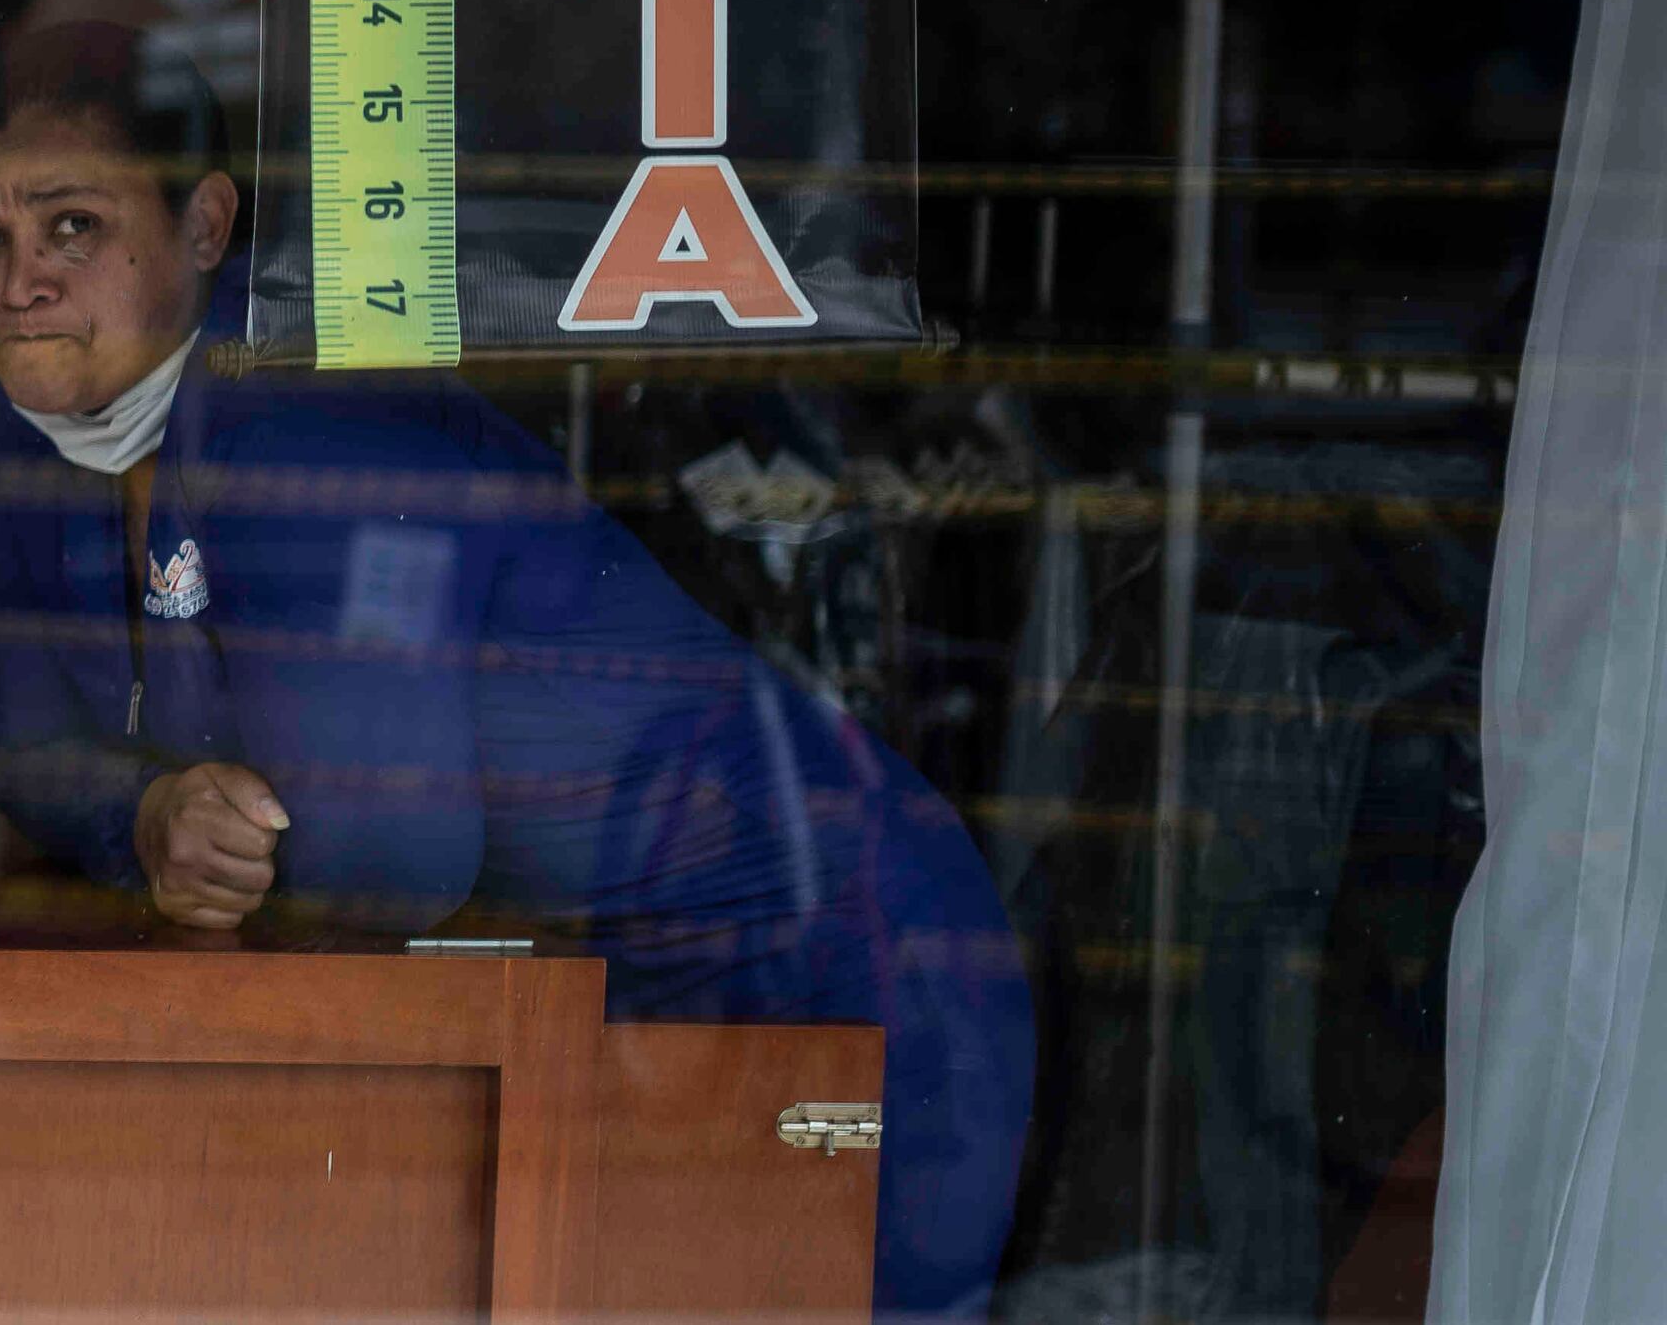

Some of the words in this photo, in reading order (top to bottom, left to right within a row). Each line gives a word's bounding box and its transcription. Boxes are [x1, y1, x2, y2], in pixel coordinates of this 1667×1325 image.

[364, 85, 402, 122] 15
[365, 182, 404, 219] 16
[367, 280, 406, 315] 17
